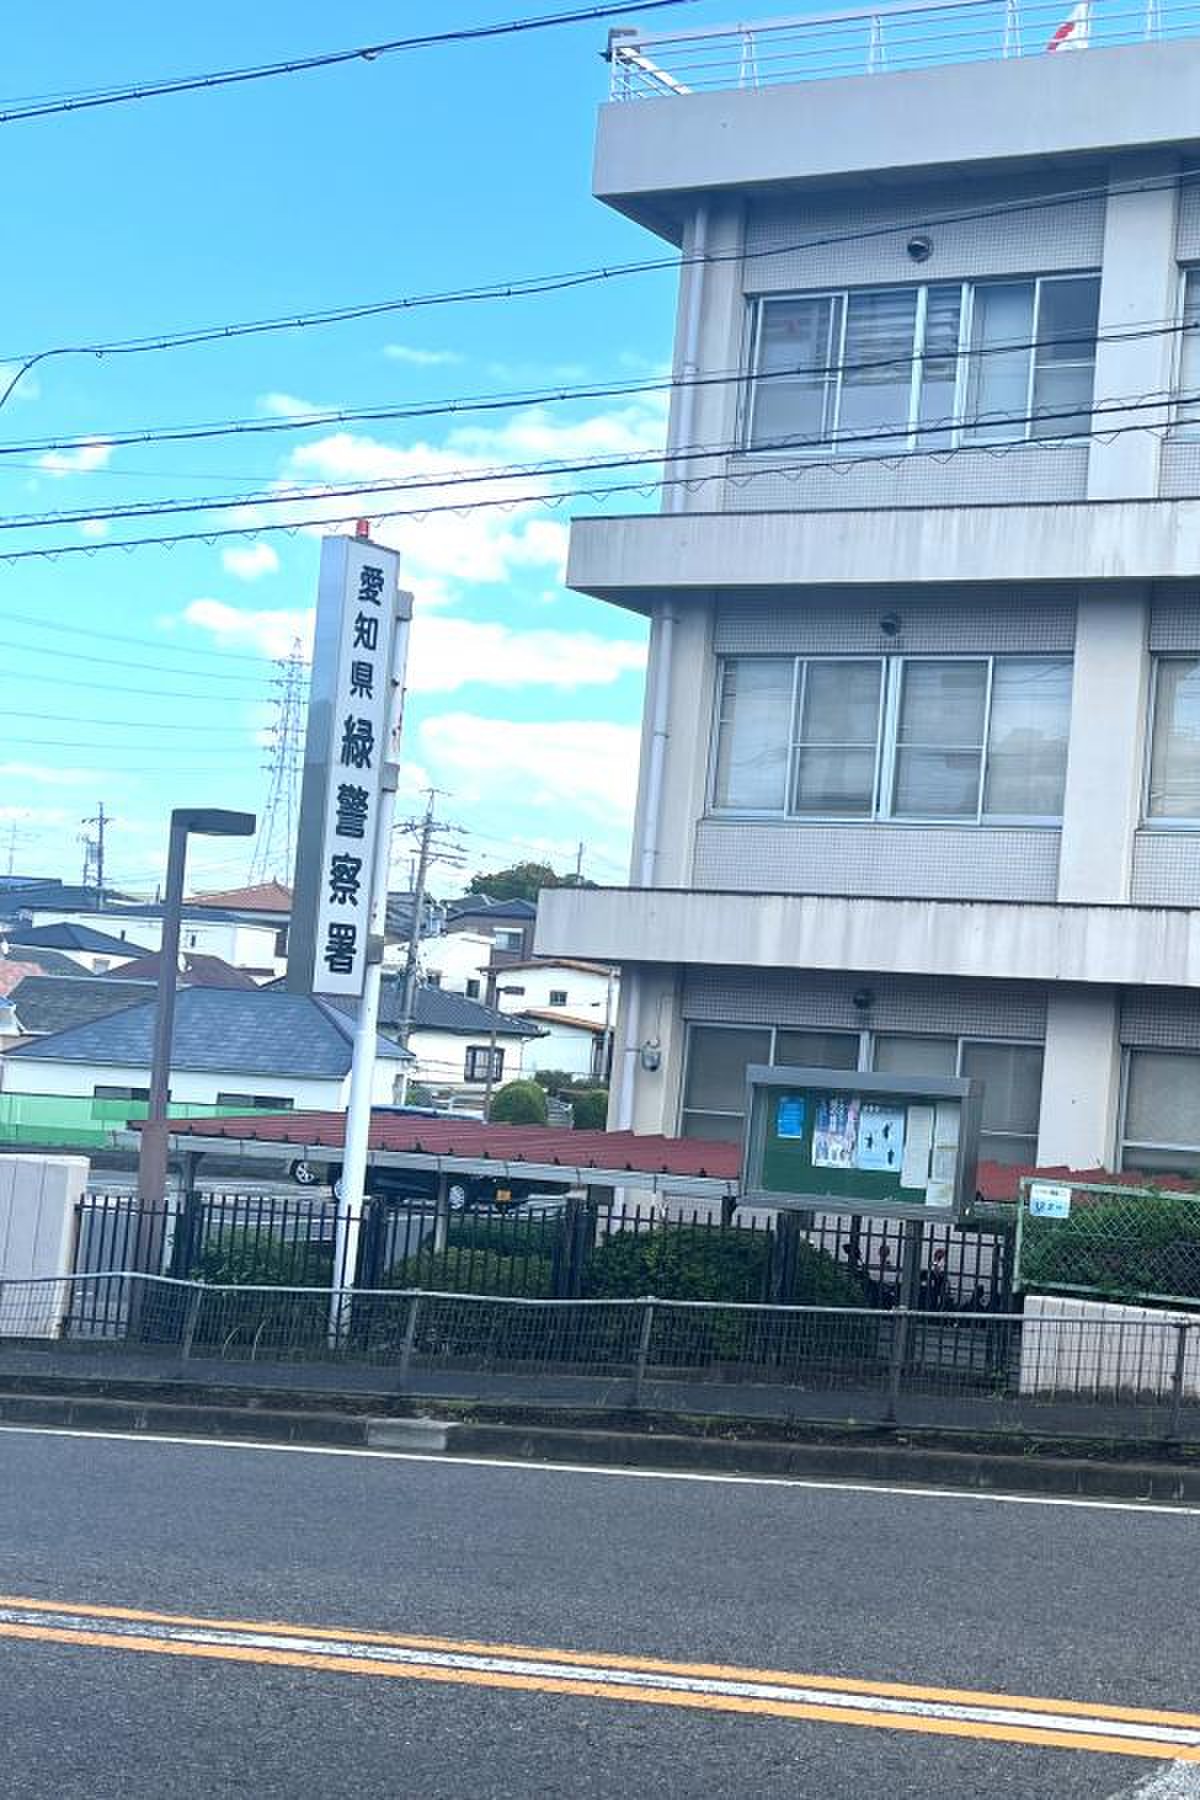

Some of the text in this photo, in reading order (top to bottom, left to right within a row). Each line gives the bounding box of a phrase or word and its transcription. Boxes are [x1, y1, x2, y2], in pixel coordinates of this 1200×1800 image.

[323, 565, 385, 975] 愛知県緑警察署
